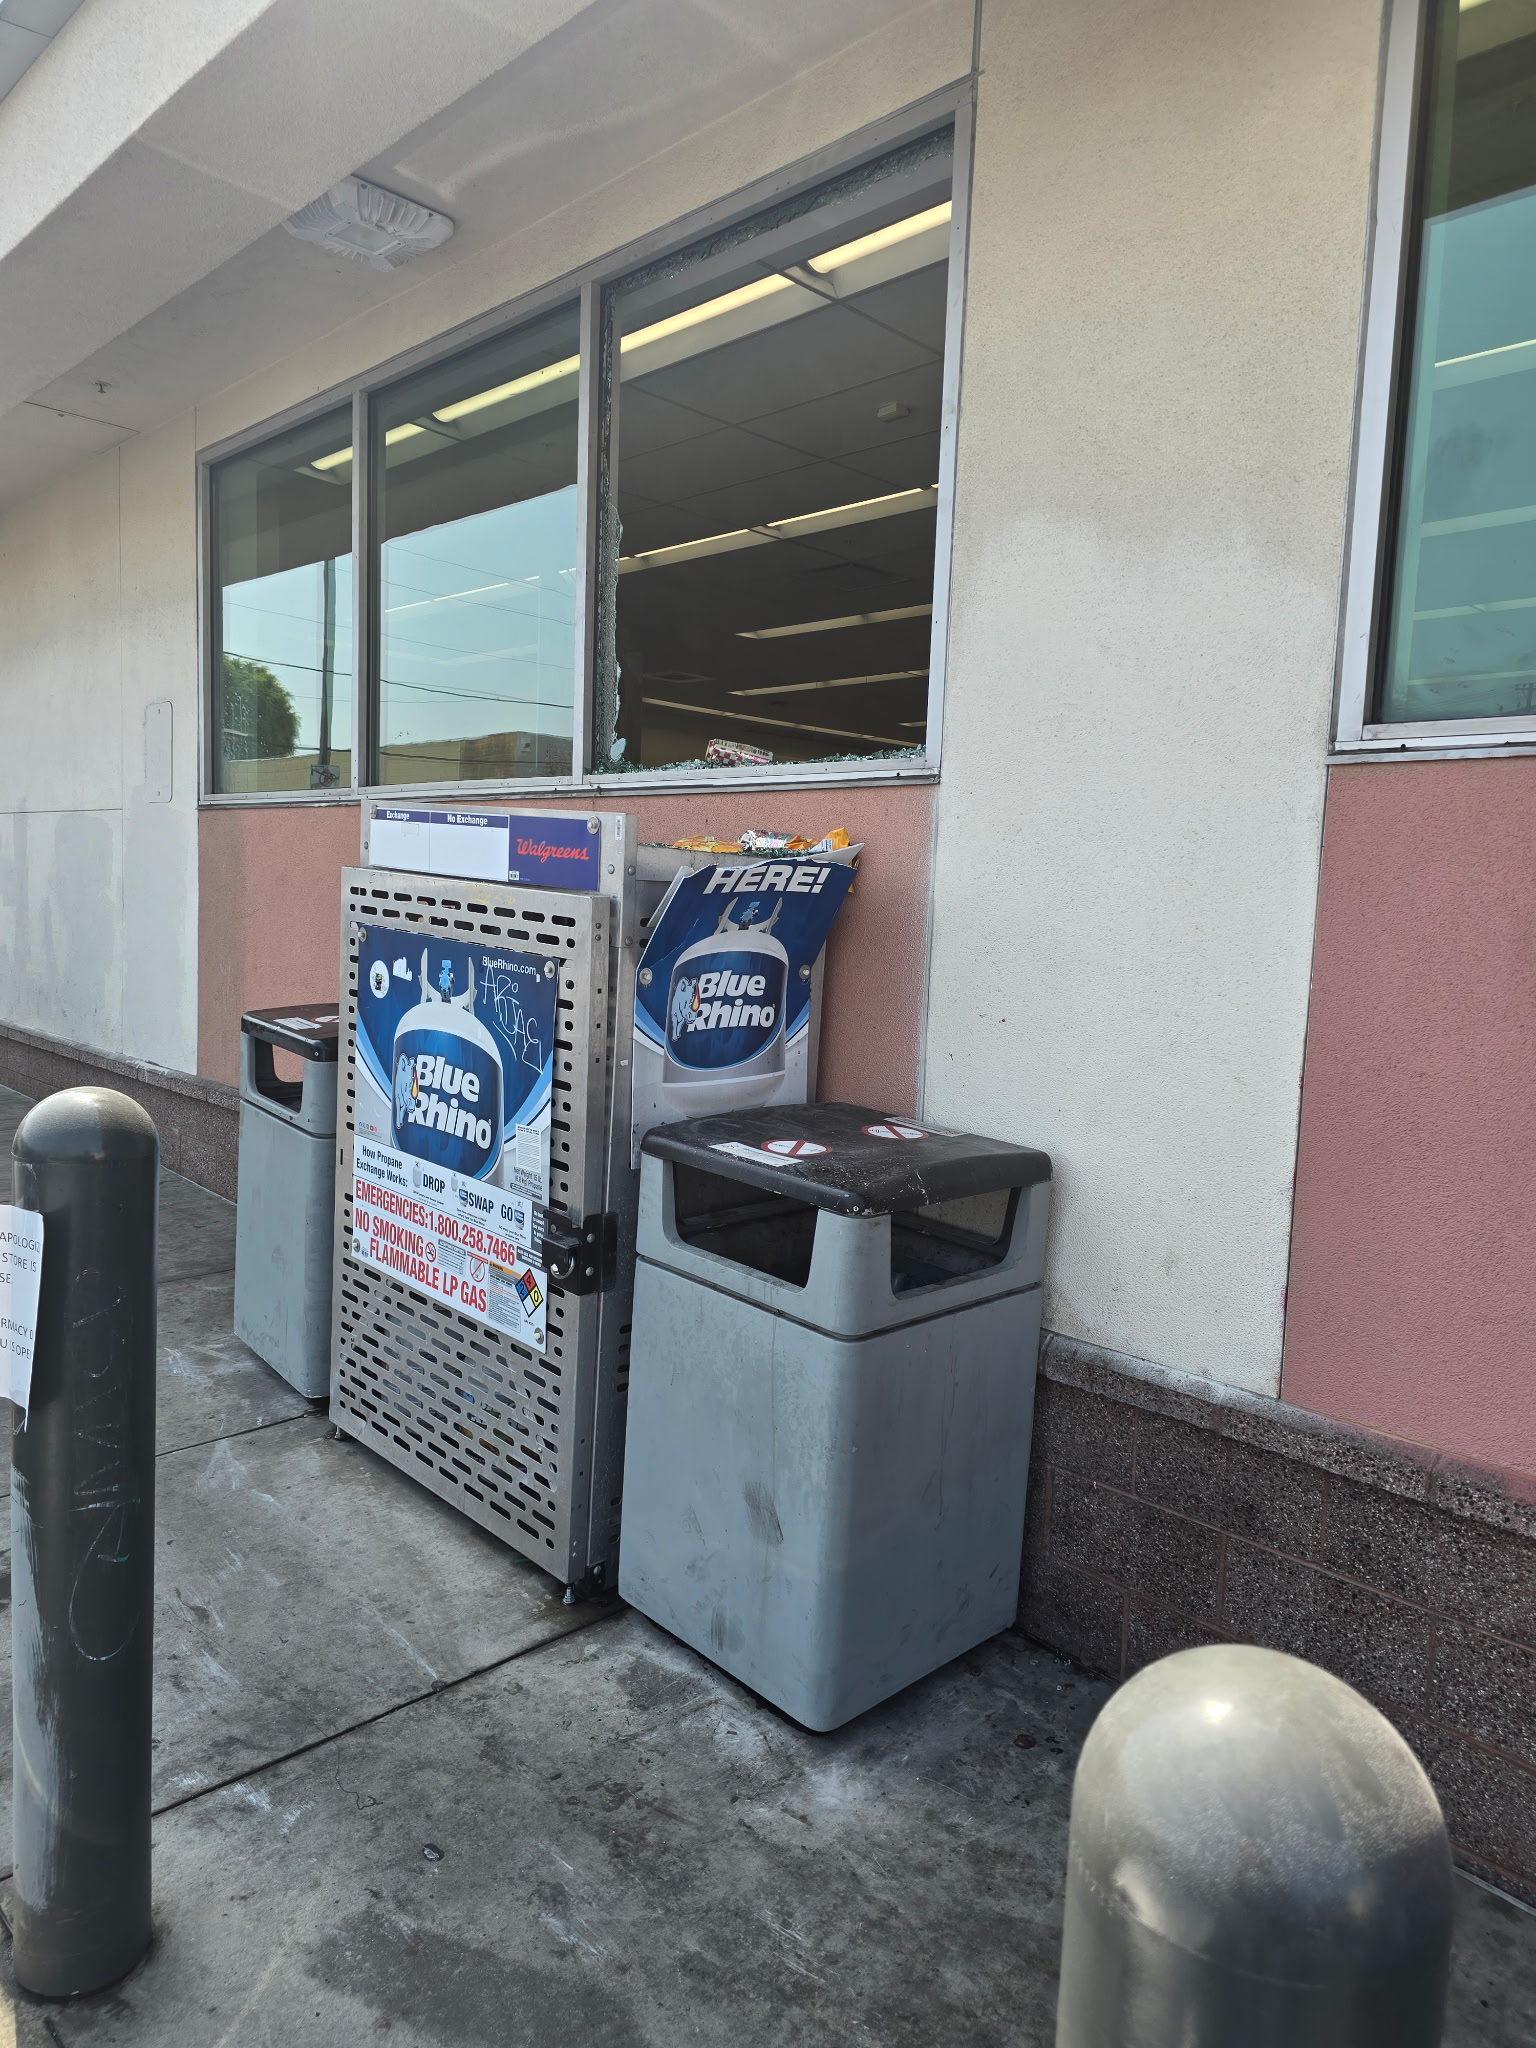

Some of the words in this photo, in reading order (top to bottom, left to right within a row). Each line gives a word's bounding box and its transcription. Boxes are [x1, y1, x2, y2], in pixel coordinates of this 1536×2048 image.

[386, 810, 410, 822] Exchange
[447, 813, 456, 824] No
[457, 814, 488, 827] Exchange
[516, 838, 590, 864] Walgreens
[702, 864, 832, 895] HERE!
[482, 955, 537, 976] BlueRhino.com
[698, 969, 766, 999] Blue
[686, 998, 775, 1033] Rhino
[416, 1054, 480, 1103] Blue
[407, 1092, 492, 1150] Rhino
[362, 1144, 376, 1160] How
[377, 1150, 403, 1170] Propane
[356, 1157, 386, 1180] Exchange
[386, 1168, 408, 1188] Works:
[423, 1173, 446, 1194] DROP
[468, 1191, 494, 1215] SWAP
[500, 1203, 513, 1222] GO
[355, 1207, 370, 1233] NO
[372, 1215, 424, 1259] SMOKING
[2, 1252, 28, 1270] STORE
[30, 1260, 37, 1273] IS
[369, 1236, 439, 1292] FLAMMABLE
[442, 1271, 459, 1298] LP
[460, 1280, 487, 1313] GAS
[519, 1282, 525, 1296] 2
[533, 1289, 540, 1303] 0
